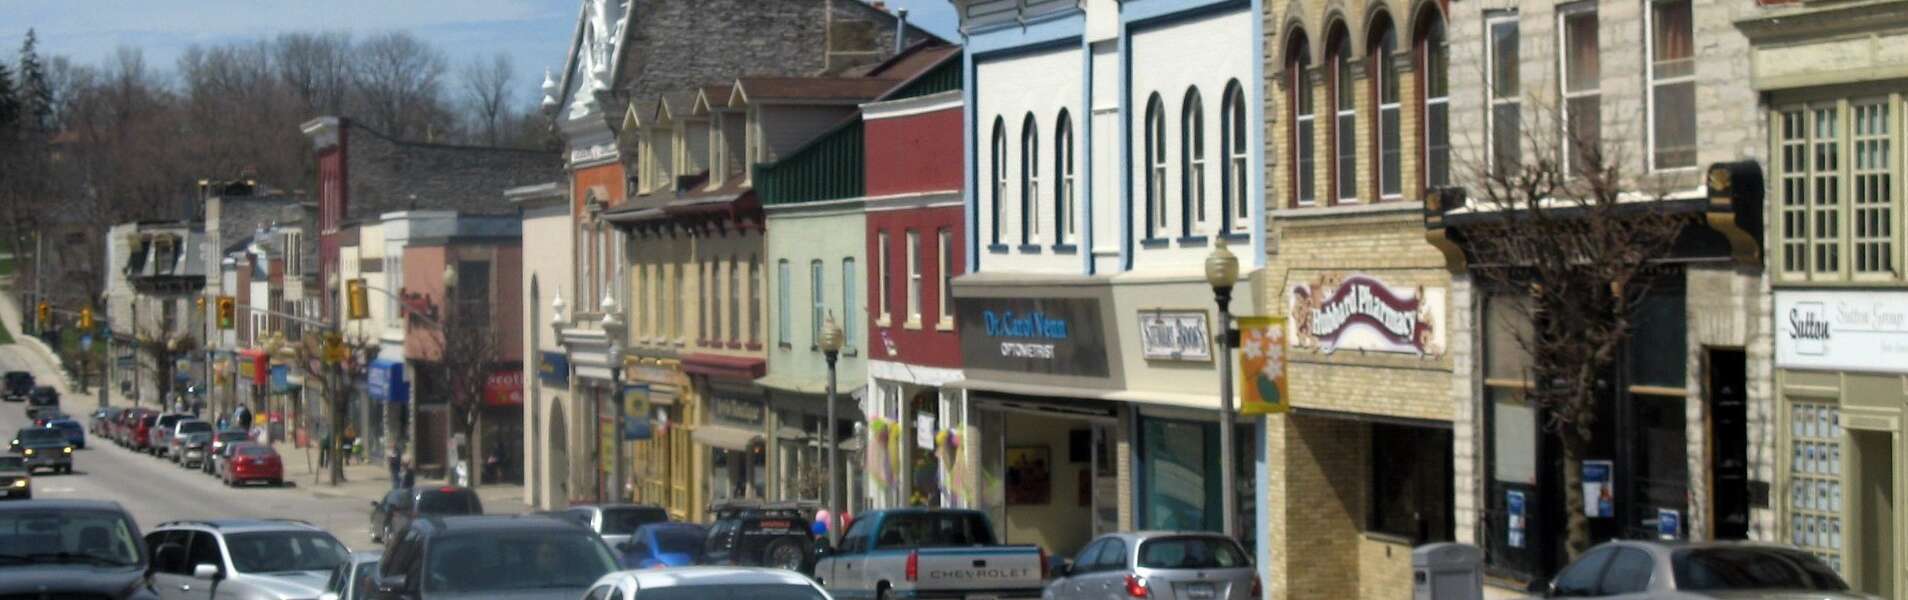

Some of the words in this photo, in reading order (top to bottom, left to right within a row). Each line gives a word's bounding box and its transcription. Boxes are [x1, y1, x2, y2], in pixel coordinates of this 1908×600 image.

[1312, 283, 1358, 336] Hubbard
[1358, 284, 1417, 341] Pharmacy
[1788, 307, 1830, 340] Sutton
[1000, 341, 1055, 359] OPTOMETRIST
[930, 568, 1028, 579] CHEVROLET
